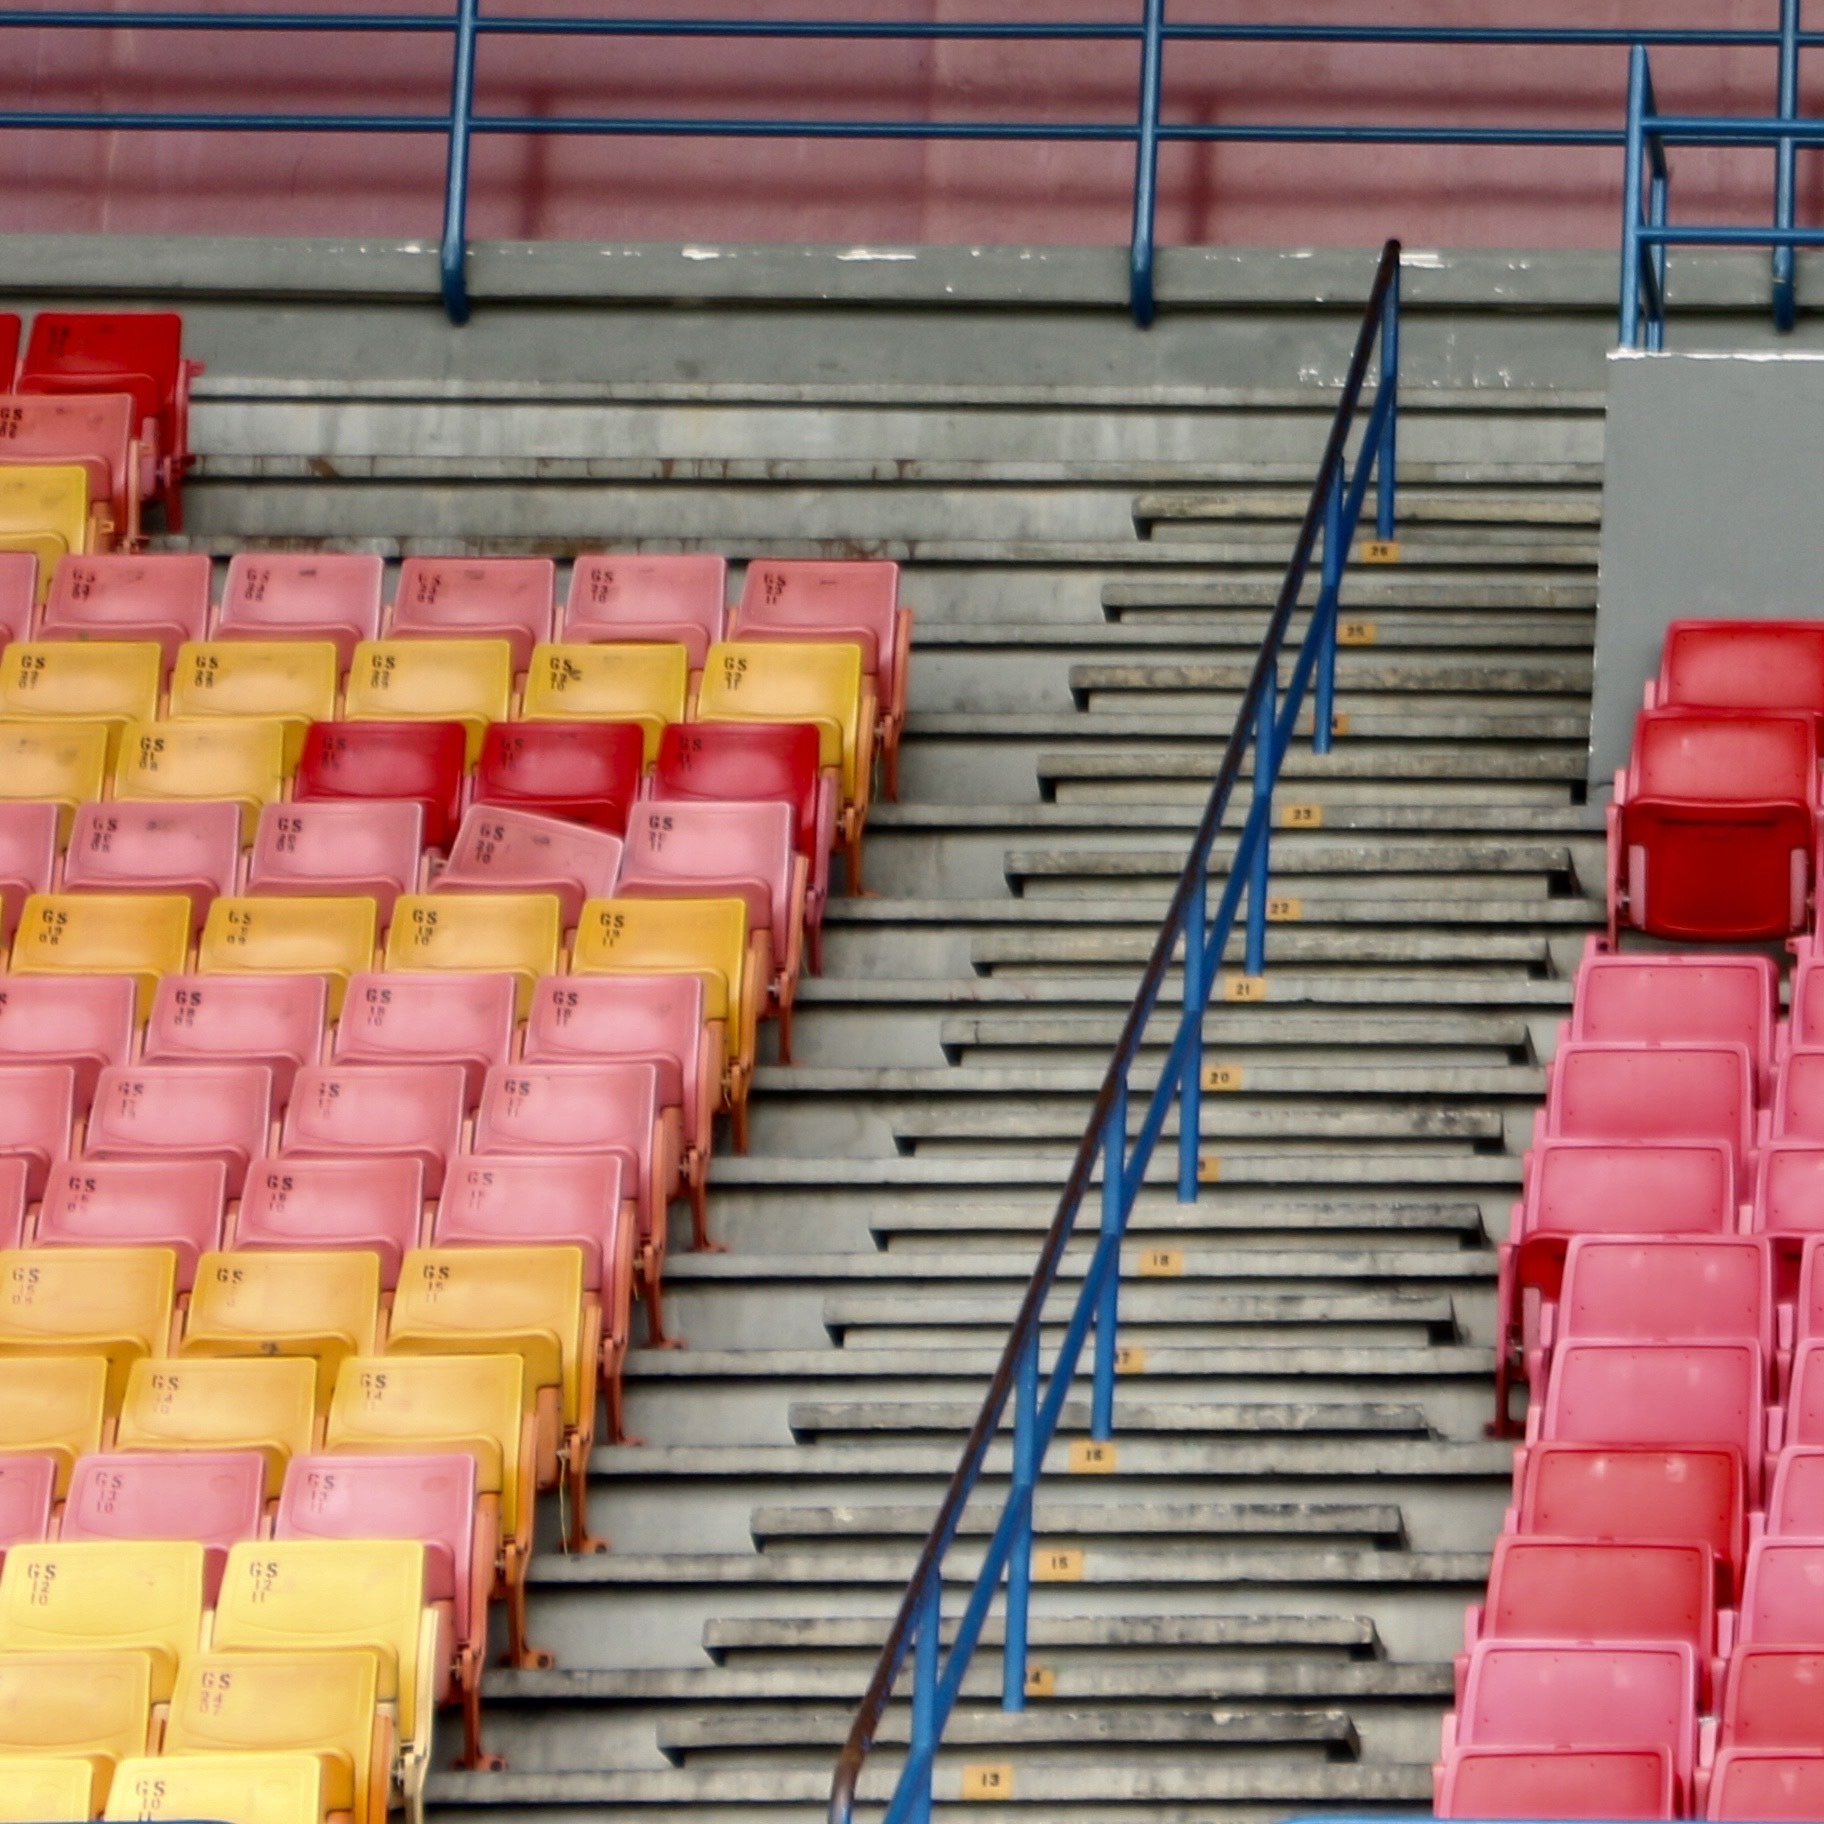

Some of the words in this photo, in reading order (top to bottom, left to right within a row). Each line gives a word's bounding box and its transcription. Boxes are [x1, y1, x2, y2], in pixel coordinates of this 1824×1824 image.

[591, 570, 614, 583] GS
[1346, 626, 1365, 637] 25
[22, 656, 45, 669] GS
[196, 656, 218, 669] GS
[372, 656, 395, 669] GS
[550, 657, 572, 670] GS
[725, 658, 747, 670] GS
[141, 738, 164, 752] GS
[1293, 809, 1311, 820] 23
[278, 818, 302, 832] GS
[649, 816, 672, 830] GS
[480, 825, 504, 841] GS
[1271, 903, 1289, 914] 22
[43, 910, 68, 925] GS
[413, 910, 437, 924] GS
[600, 913, 624, 928] GS
[366, 988, 391, 1003] GS
[1236, 983, 1250, 995] 21
[176, 990, 201, 1005] GS
[553, 991, 578, 1006] GS
[1210, 1072, 1230, 1084] 20
[505, 1080, 530, 1096] GS
[69, 1176, 96, 1192] GS
[267, 1176, 293, 1191] GS
[467, 1172, 493, 1185] GS
[1153, 1255, 1169, 1266] 18
[13, 1268, 39, 1283] GS
[217, 1268, 243, 1284] GS
[424, 1266, 449, 1279] GS
[153, 1375, 179, 1390] GS
[362, 1374, 386, 1389] GS
[96, 1472, 122, 1488] GS
[308, 1474, 334, 1489] GS
[1052, 1556, 1069, 1569] 15
[28, 1563, 56, 1580] GS
[250, 1562, 277, 1578] GS
[202, 1672, 230, 1688] GS
[981, 1773, 1000, 1787] 13
